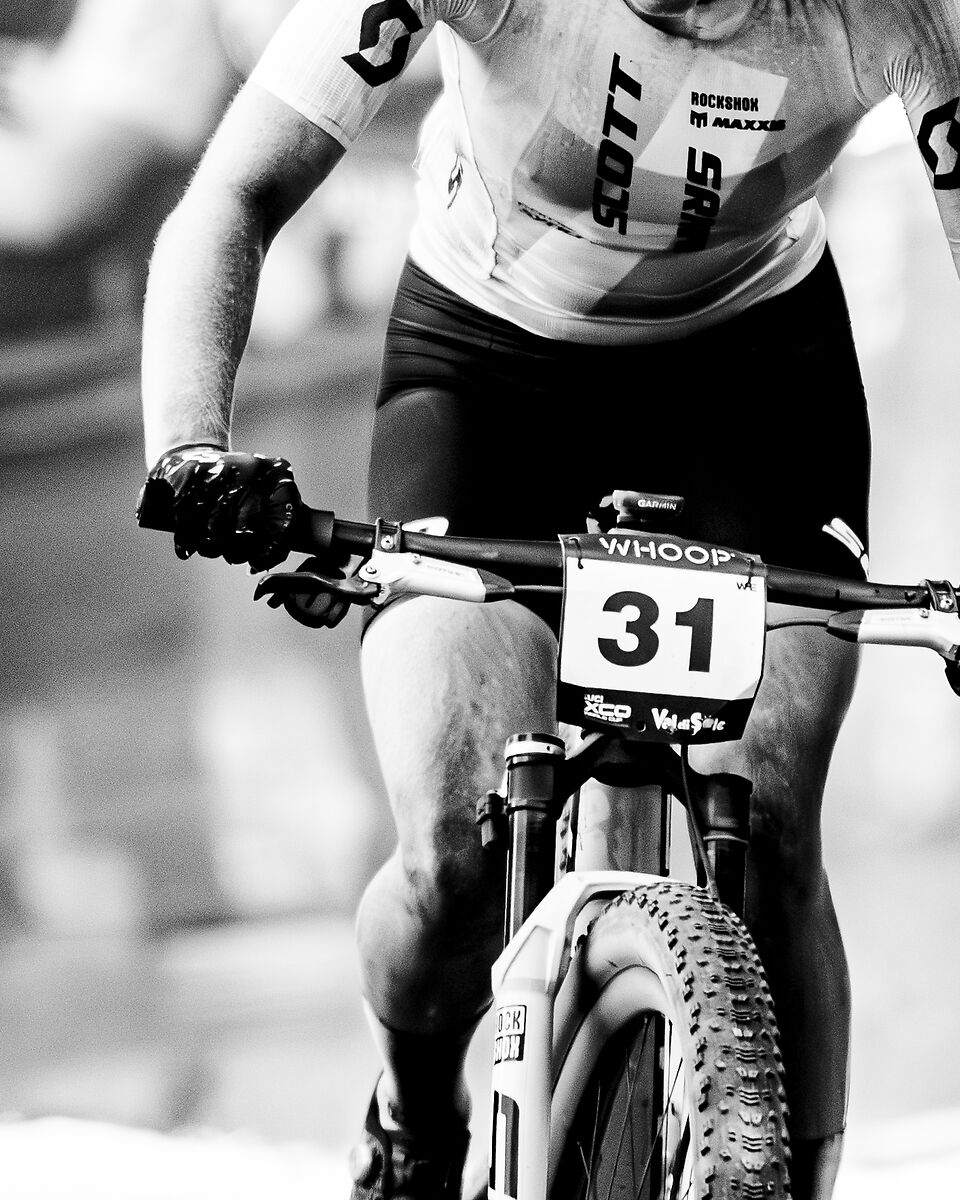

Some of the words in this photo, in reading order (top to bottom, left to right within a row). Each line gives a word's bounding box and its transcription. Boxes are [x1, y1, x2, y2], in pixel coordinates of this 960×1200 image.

[690, 91, 759, 112] ROCKSHOX
[711, 116, 786, 131] MAXXIS
[592, 52, 642, 236] SCOTT
[637, 499, 677, 511] GARMIN
[599, 537, 732, 566] WHOOP
[597, 590, 715, 673] 31
[584, 700, 632, 718] XCO
[496, 1010, 521, 1033] OCK
[494, 1035, 521, 1062] HOX
